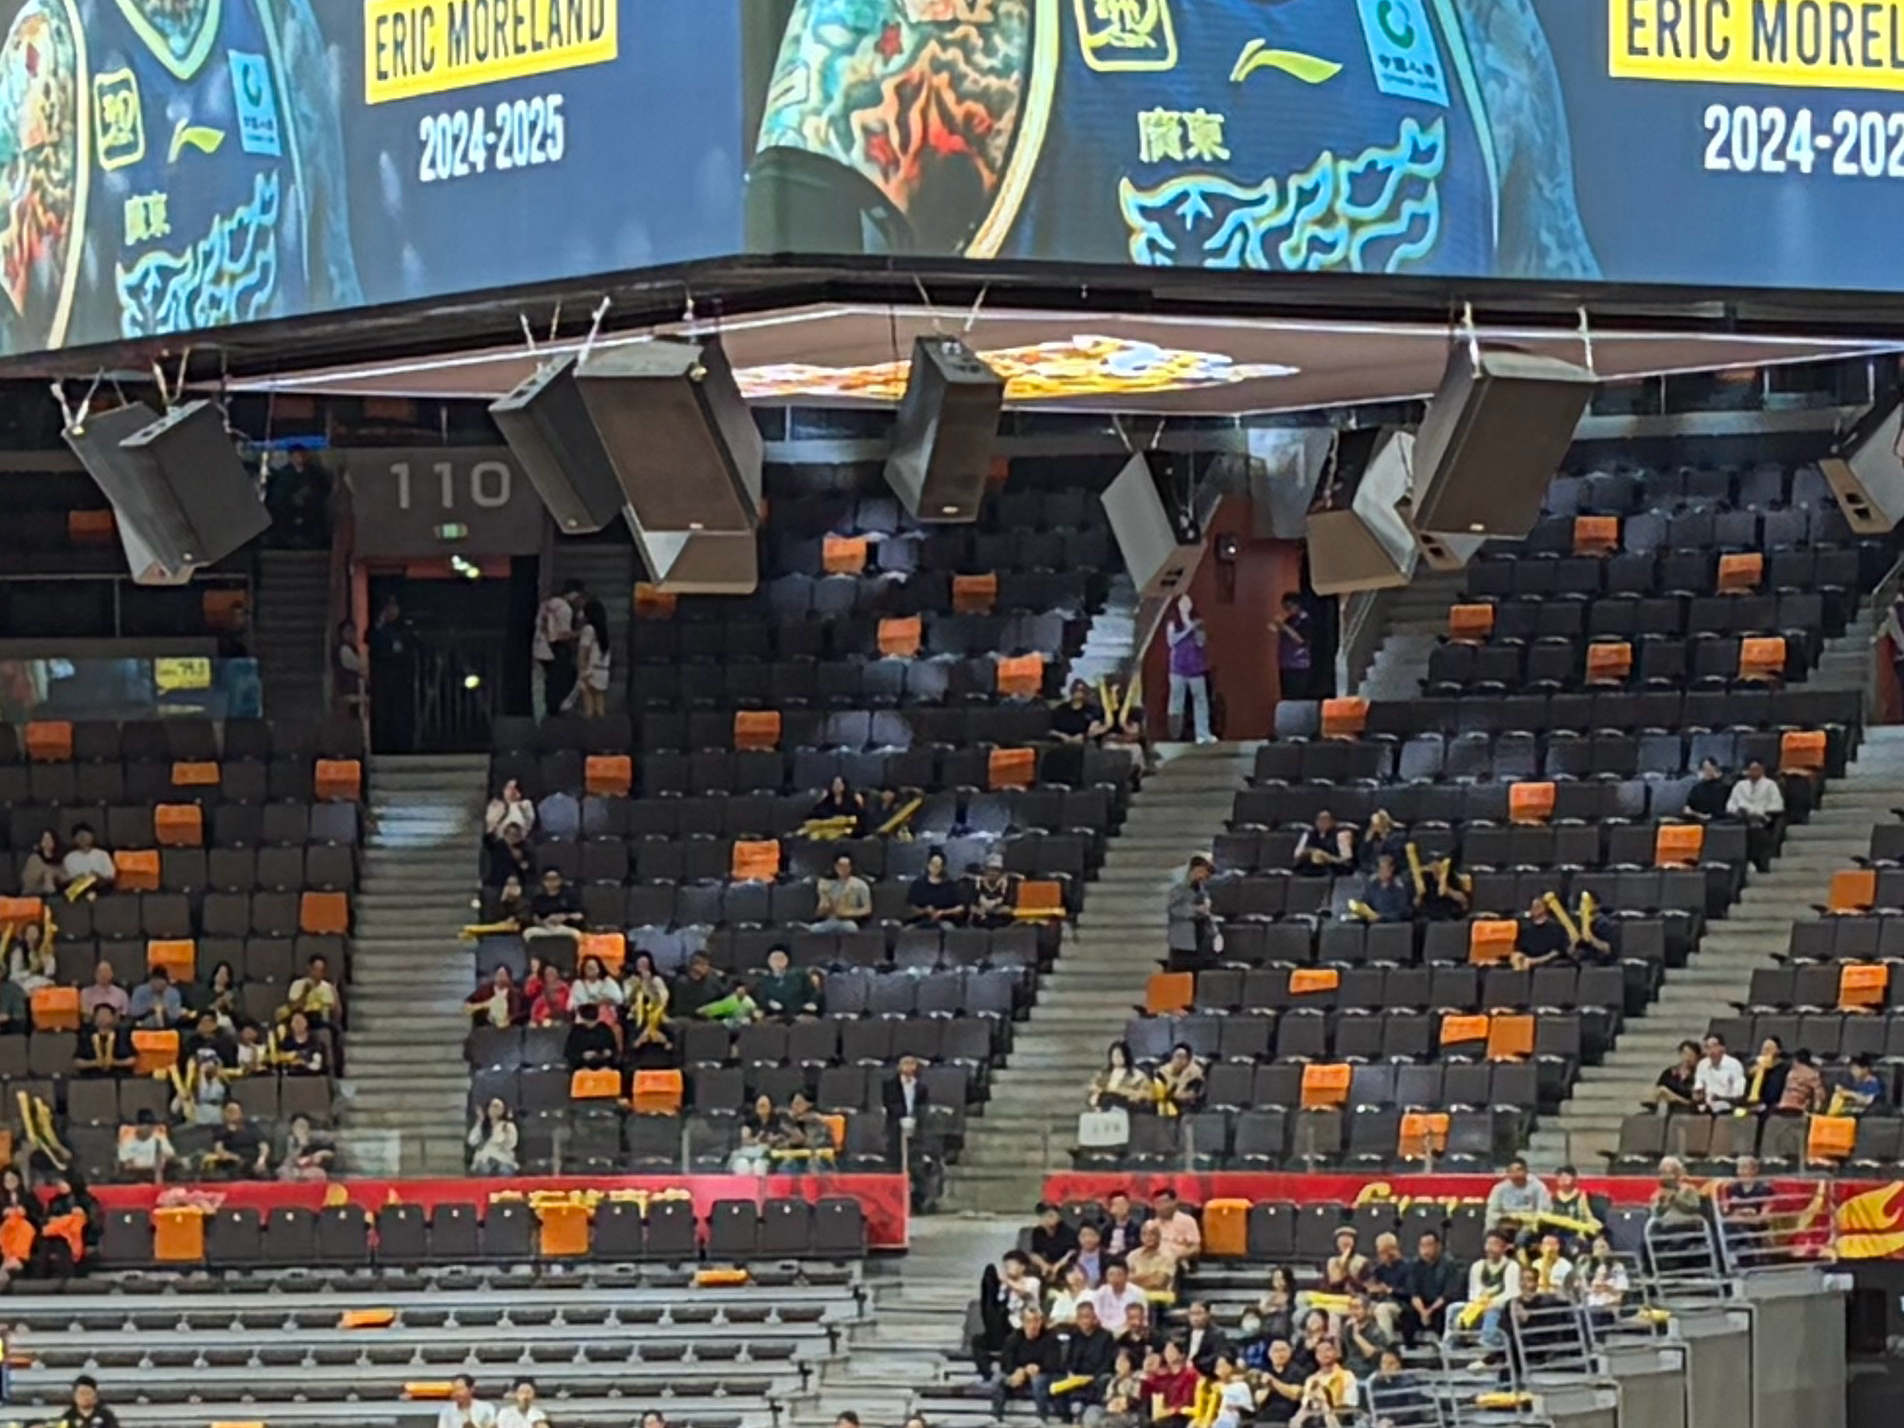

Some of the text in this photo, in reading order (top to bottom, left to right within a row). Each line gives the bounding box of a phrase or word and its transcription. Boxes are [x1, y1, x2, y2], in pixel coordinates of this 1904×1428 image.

[374, 6, 437, 82] ERIC
[419, 93, 565, 184] 2024-2025
[388, 460, 512, 509] 110
